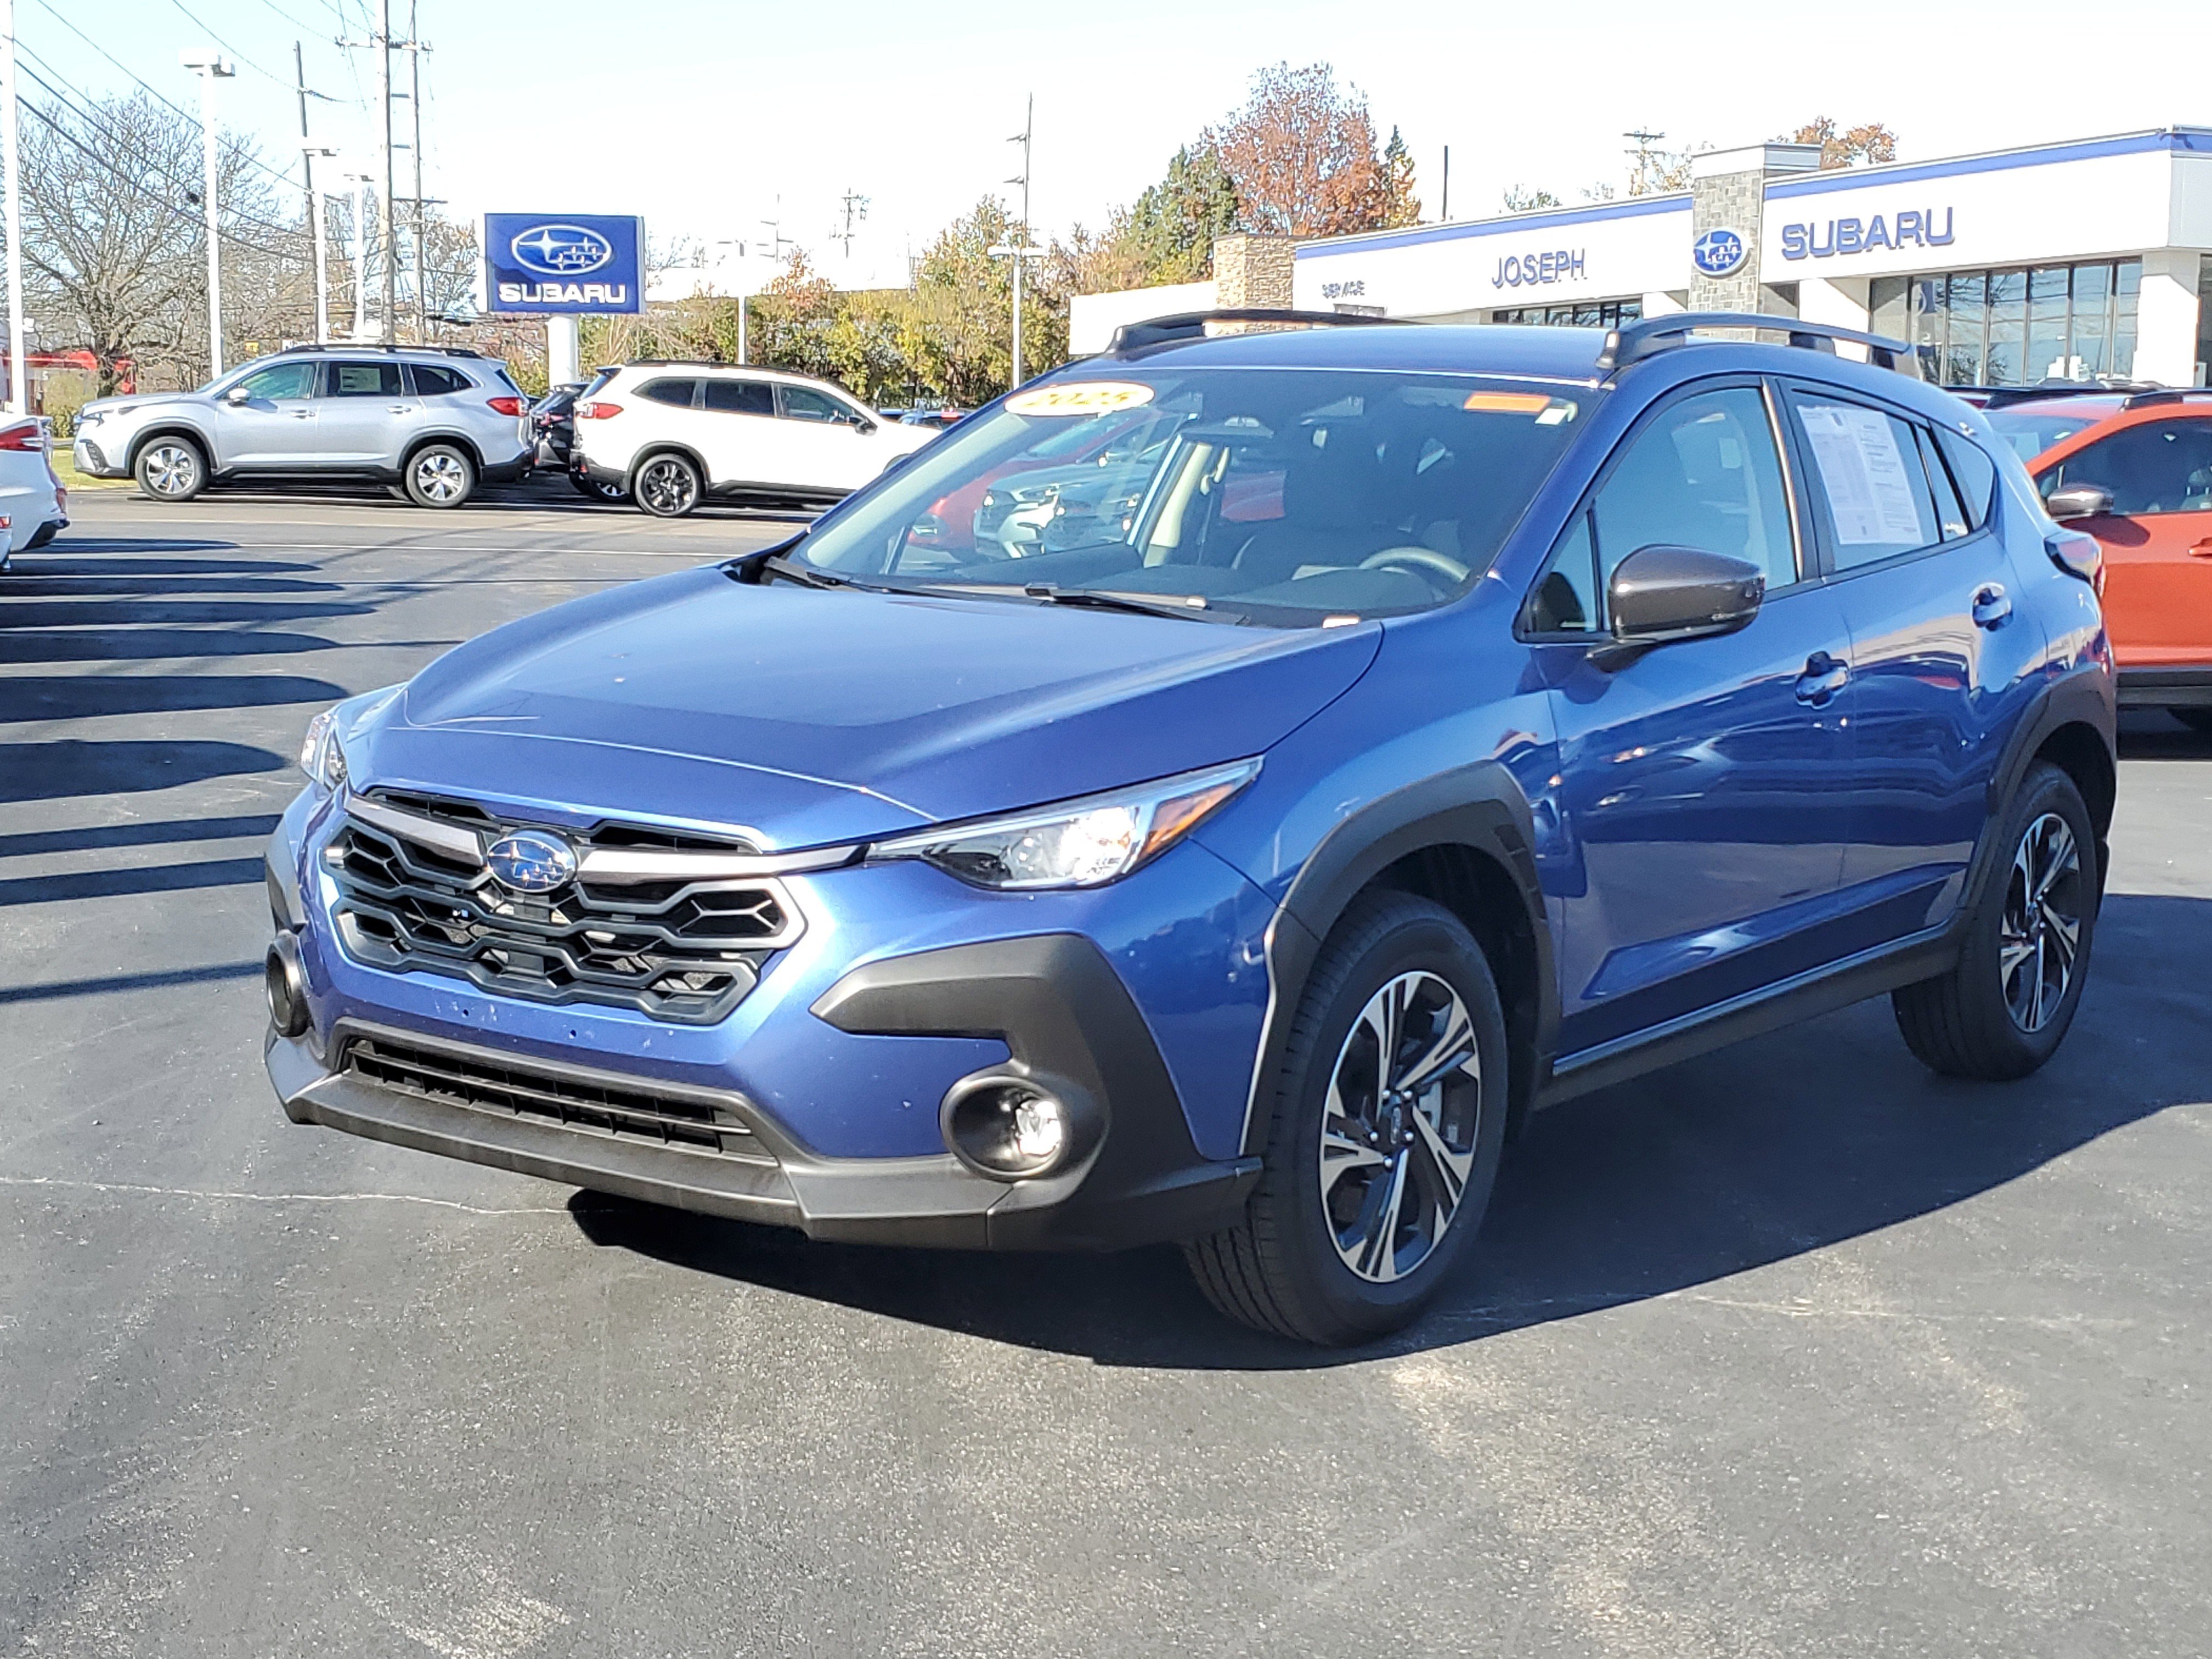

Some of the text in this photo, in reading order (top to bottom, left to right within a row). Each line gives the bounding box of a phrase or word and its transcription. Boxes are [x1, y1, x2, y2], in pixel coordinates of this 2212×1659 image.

[1781, 207, 1955, 261] SUBARU
[1491, 248, 1587, 289] JOSEPH
[499, 283, 625, 303] SUBARU
